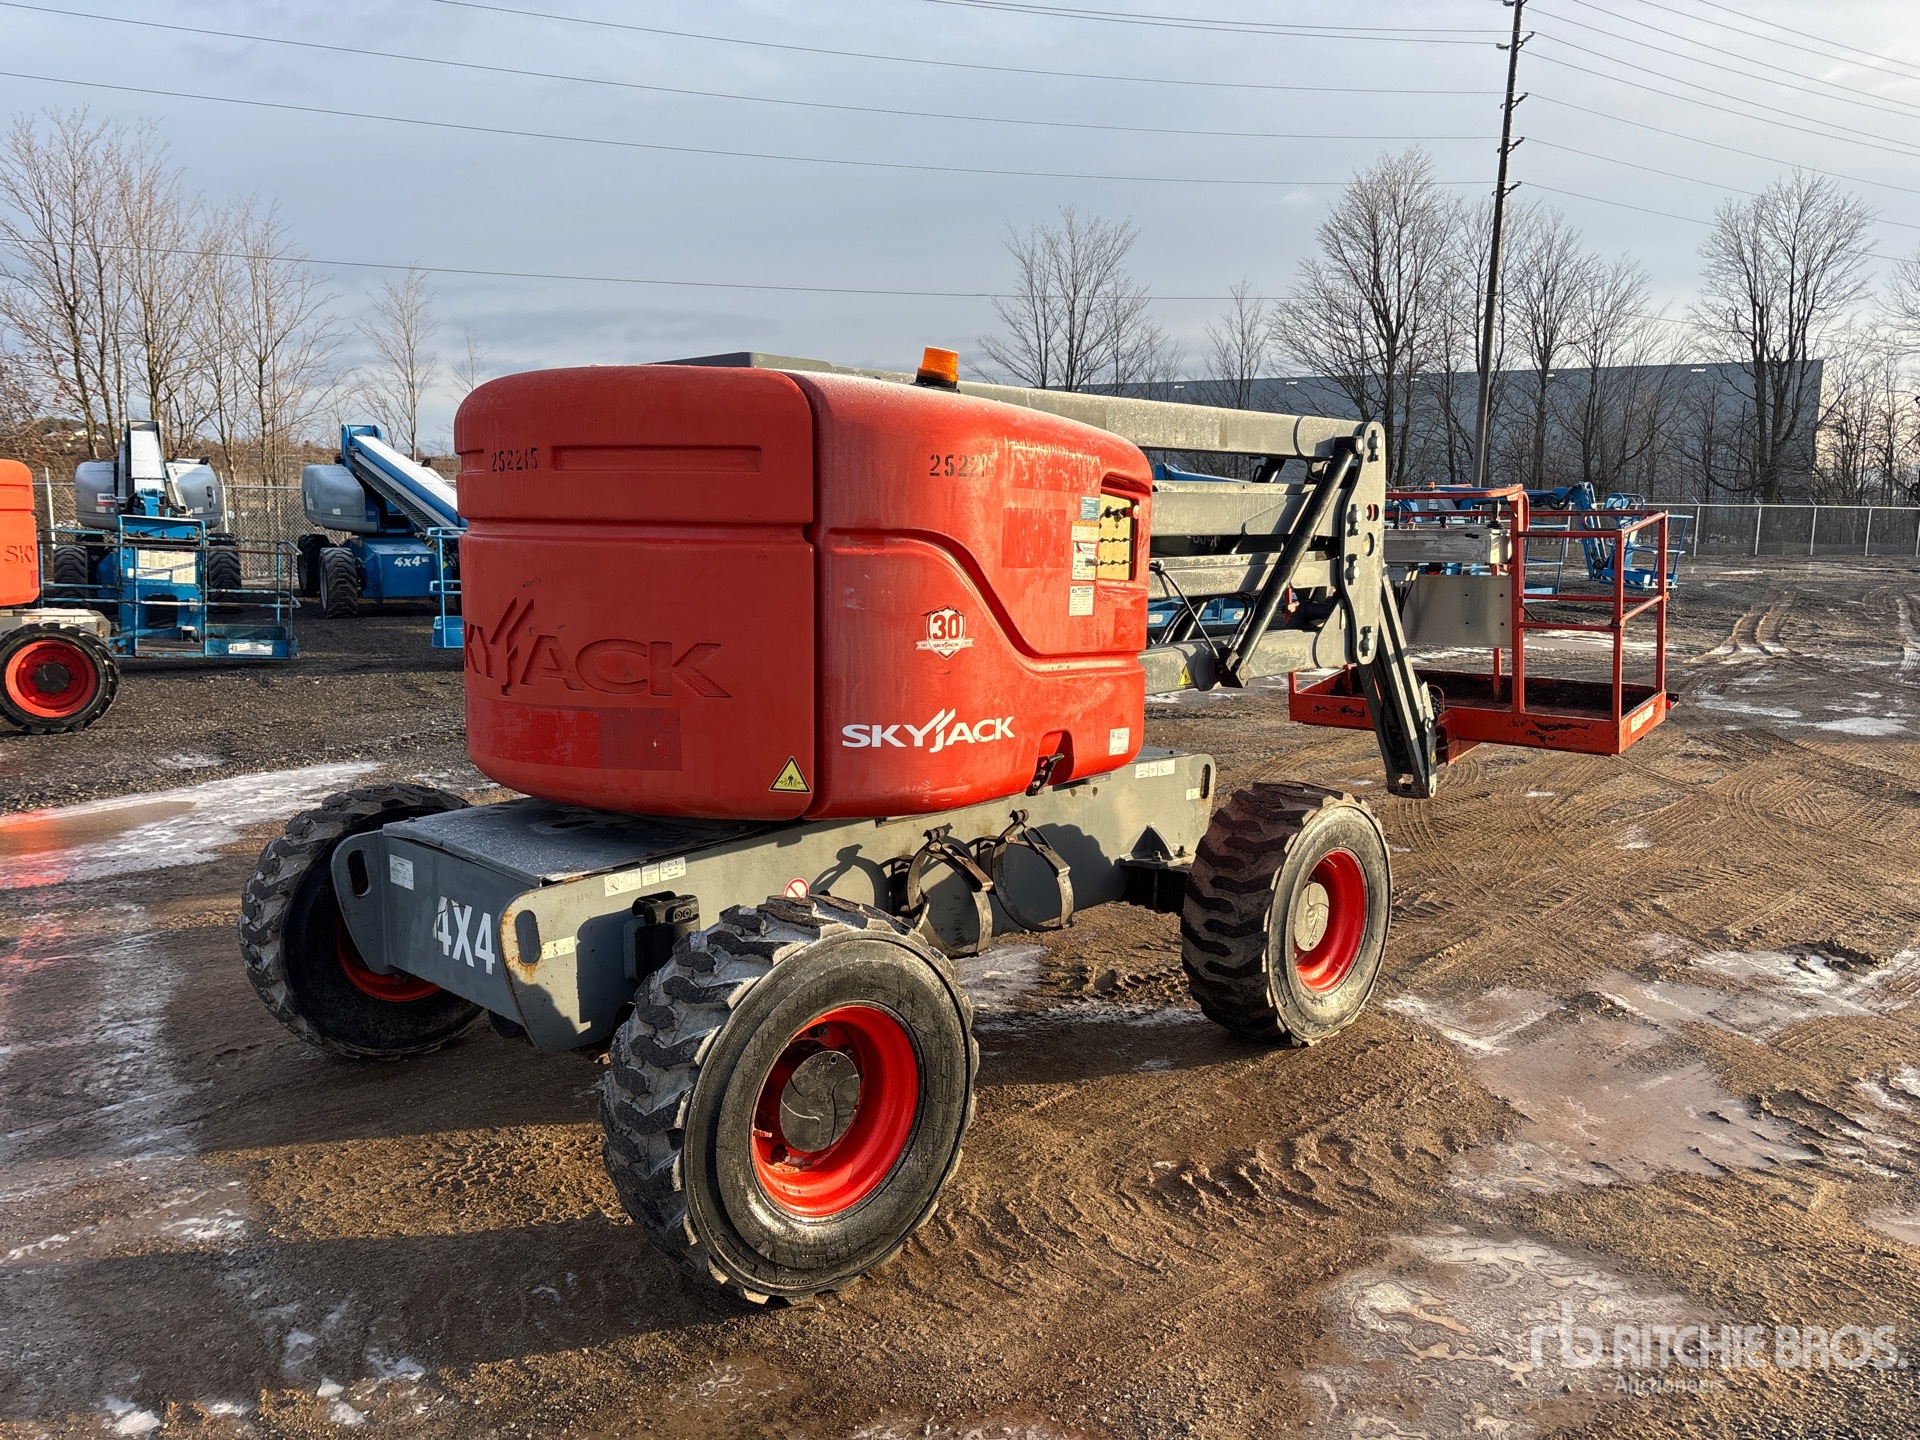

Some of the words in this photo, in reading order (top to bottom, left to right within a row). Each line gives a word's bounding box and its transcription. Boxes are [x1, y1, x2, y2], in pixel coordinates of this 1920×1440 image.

[491, 447, 538, 472] 252215
[932, 614, 960, 640] 30
[841, 707, 1016, 754] SKYJACK
